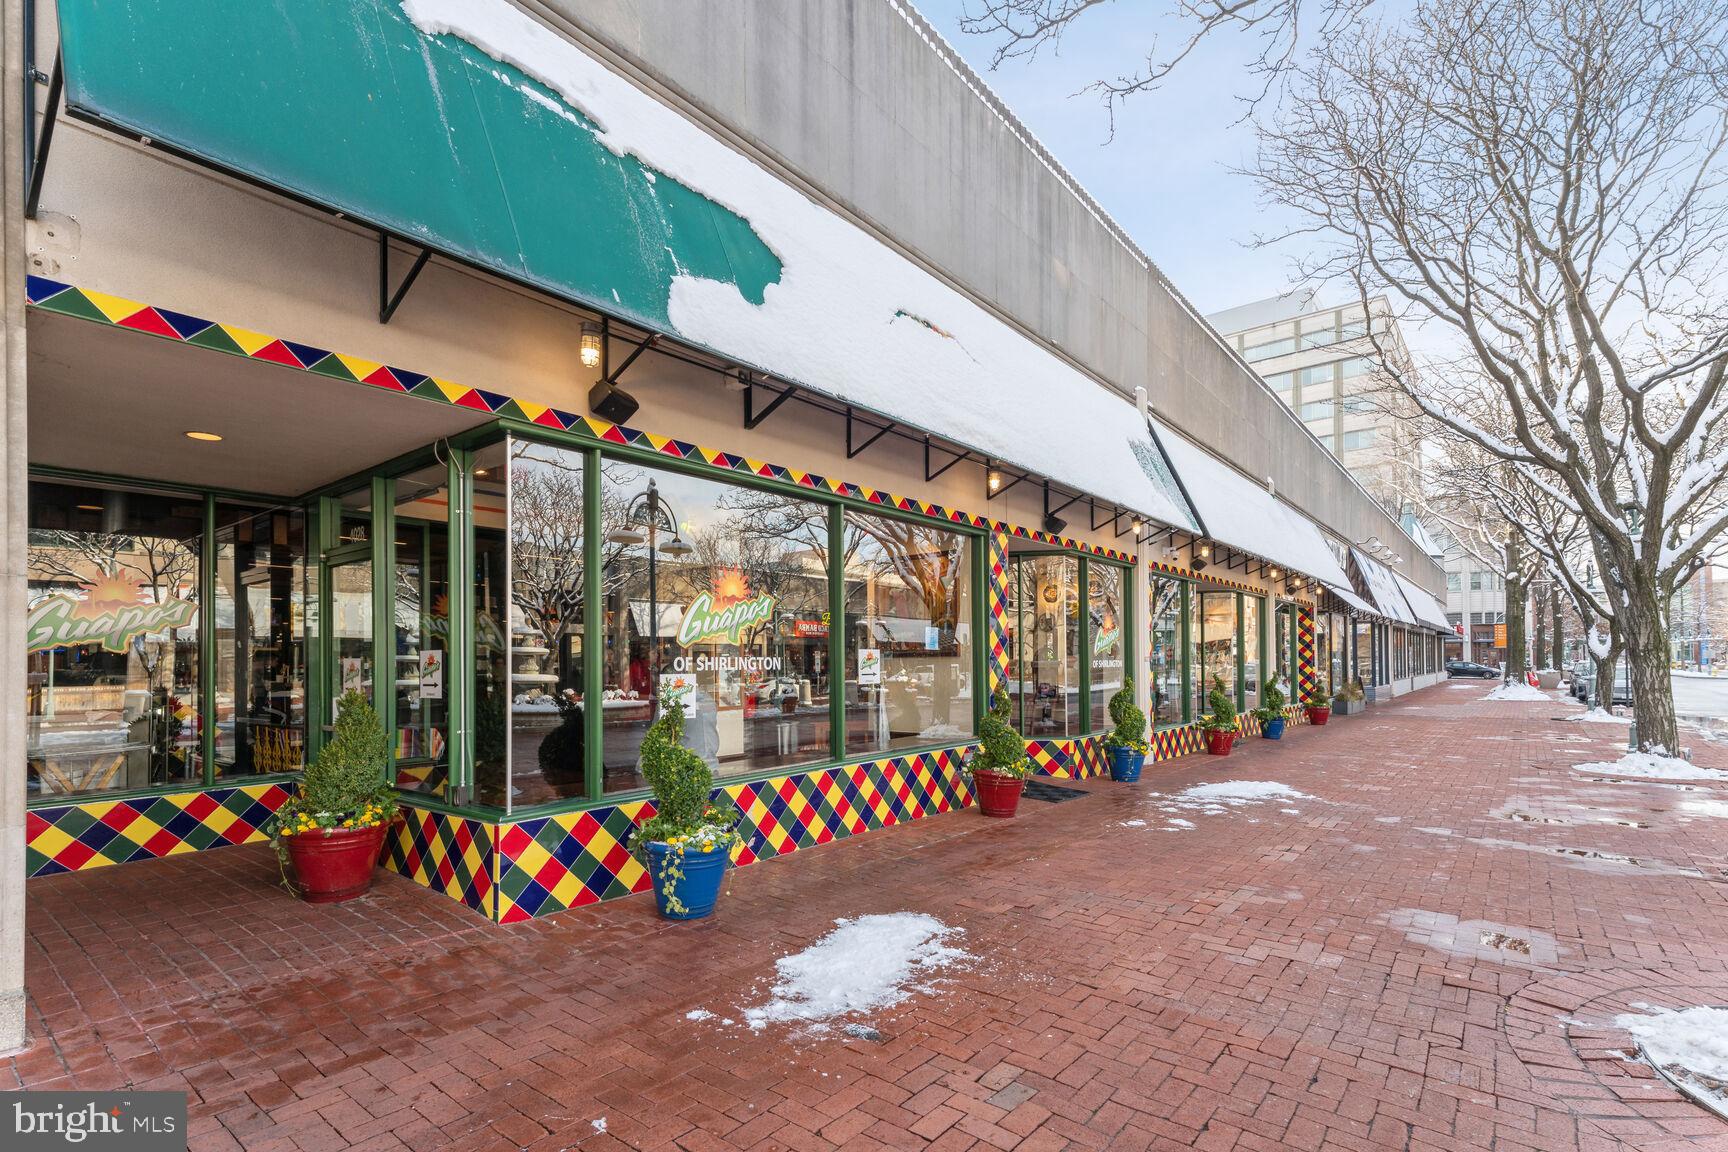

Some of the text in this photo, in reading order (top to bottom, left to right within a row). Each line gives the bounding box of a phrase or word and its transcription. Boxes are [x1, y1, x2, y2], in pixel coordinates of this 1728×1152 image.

[679, 593, 771, 645] Guapo's
[673, 656, 781, 671] OF SHIRLINGTON
